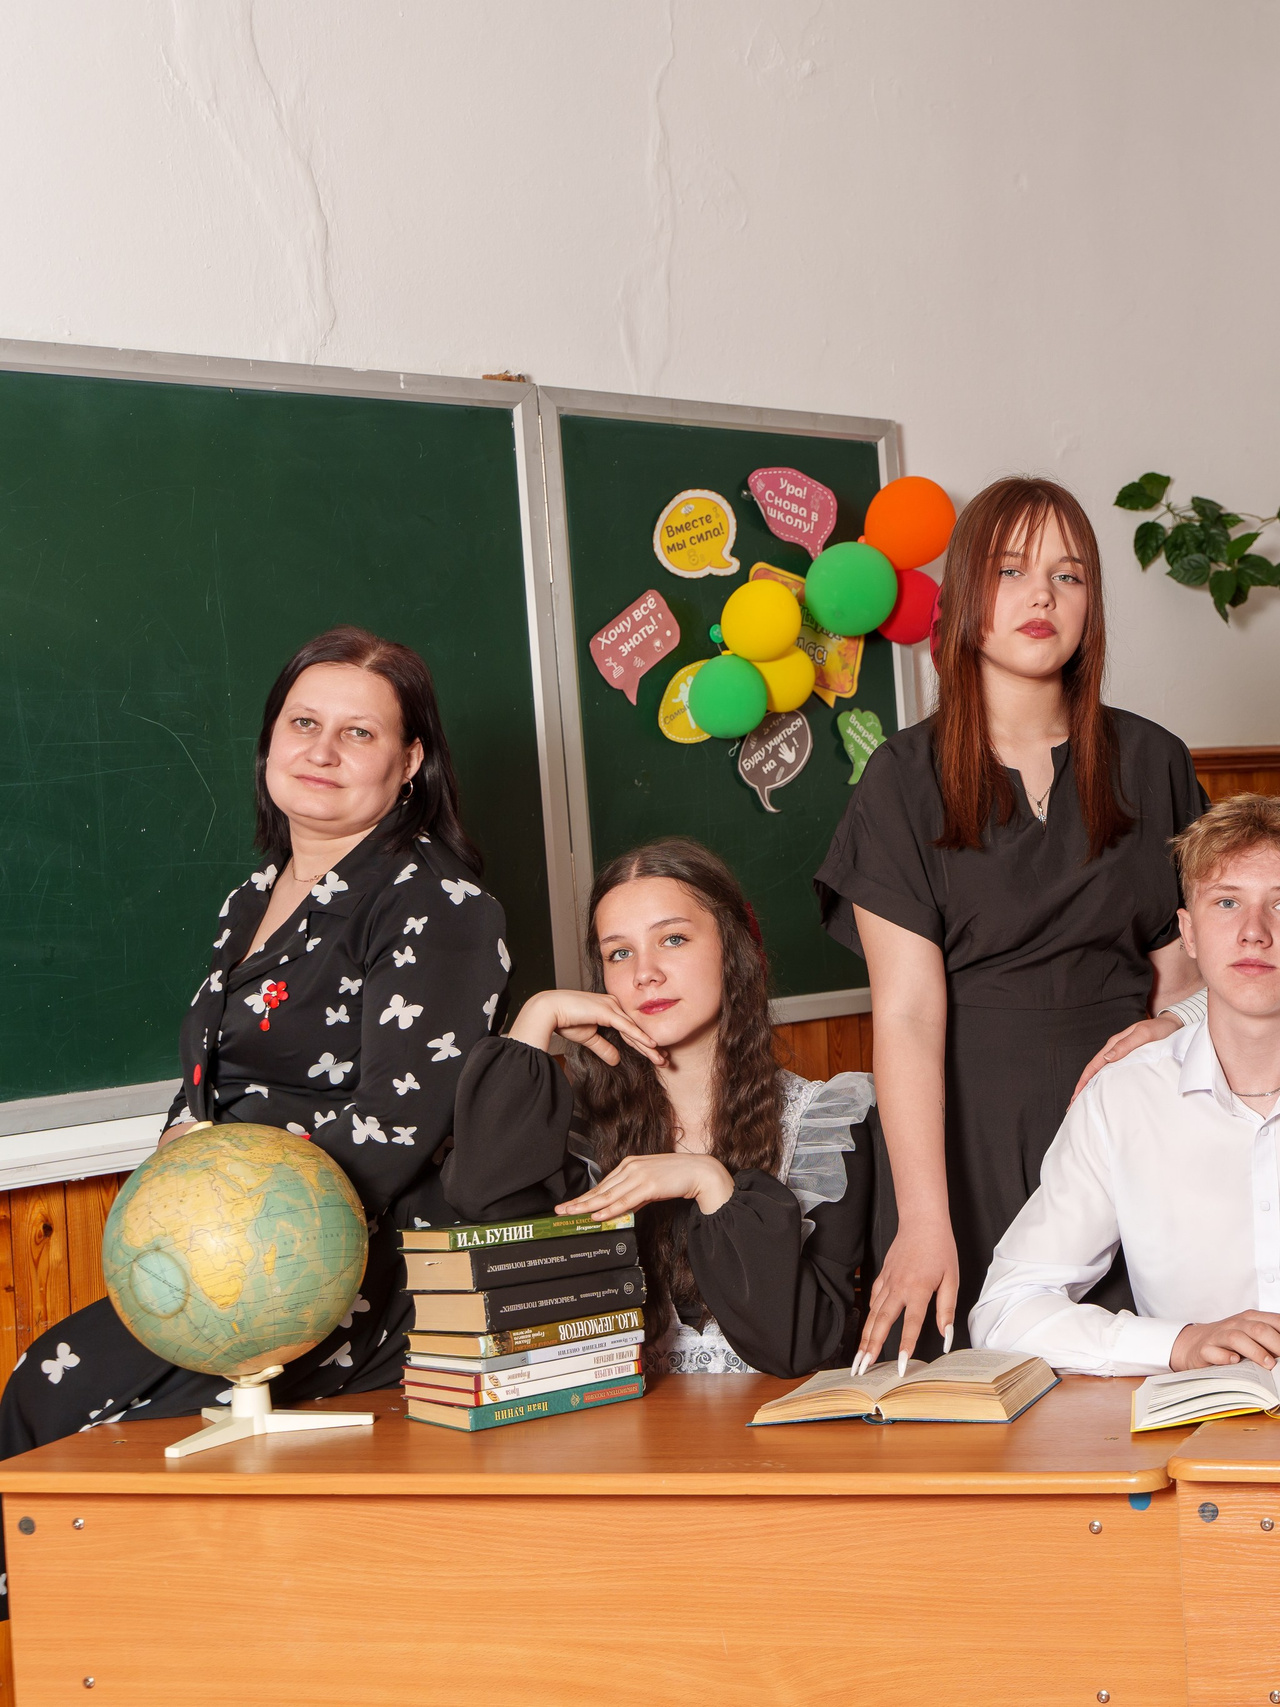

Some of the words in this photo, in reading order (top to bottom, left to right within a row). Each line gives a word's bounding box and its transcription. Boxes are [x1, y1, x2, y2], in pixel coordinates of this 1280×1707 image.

[779, 477, 808, 500] Ура!
[765, 490, 807, 518] Снова
[811, 511, 819, 522] в
[665, 514, 713, 538] Вместе
[766, 506, 815, 534] школу!
[666, 539, 687, 554] мы
[689, 522, 725, 546] сила!
[597, 616, 632, 650] Хочу
[632, 594, 657, 622] всё
[618, 615, 659, 657] знать!
[741, 747, 766, 771] Буду
[765, 717, 803, 754] учиться
[761, 759, 777, 774] на
[552, 1219, 575, 1228] МИРОВАЯ
[575, 1217, 596, 1225] КЛАСС
[456, 1231, 485, 1248] И.А.
[486, 1224, 535, 1245] БУНИН
[558, 1315, 615, 1341] ЛЕРМОНТОВ
[615, 1311, 639, 1330] М.Ю.
[557, 1347, 581, 1356] ОНЕГИН
[581, 1342, 607, 1353] ЕВГЕНИЙ
[614, 1349, 634, 1362] МАРИНА
[593, 1353, 615, 1365] ЦВЕТАЕВА
[594, 1368, 614, 1379] АНДРЕЕВ
[494, 1406, 525, 1421] БУНИН
[527, 1401, 549, 1412] Иван
